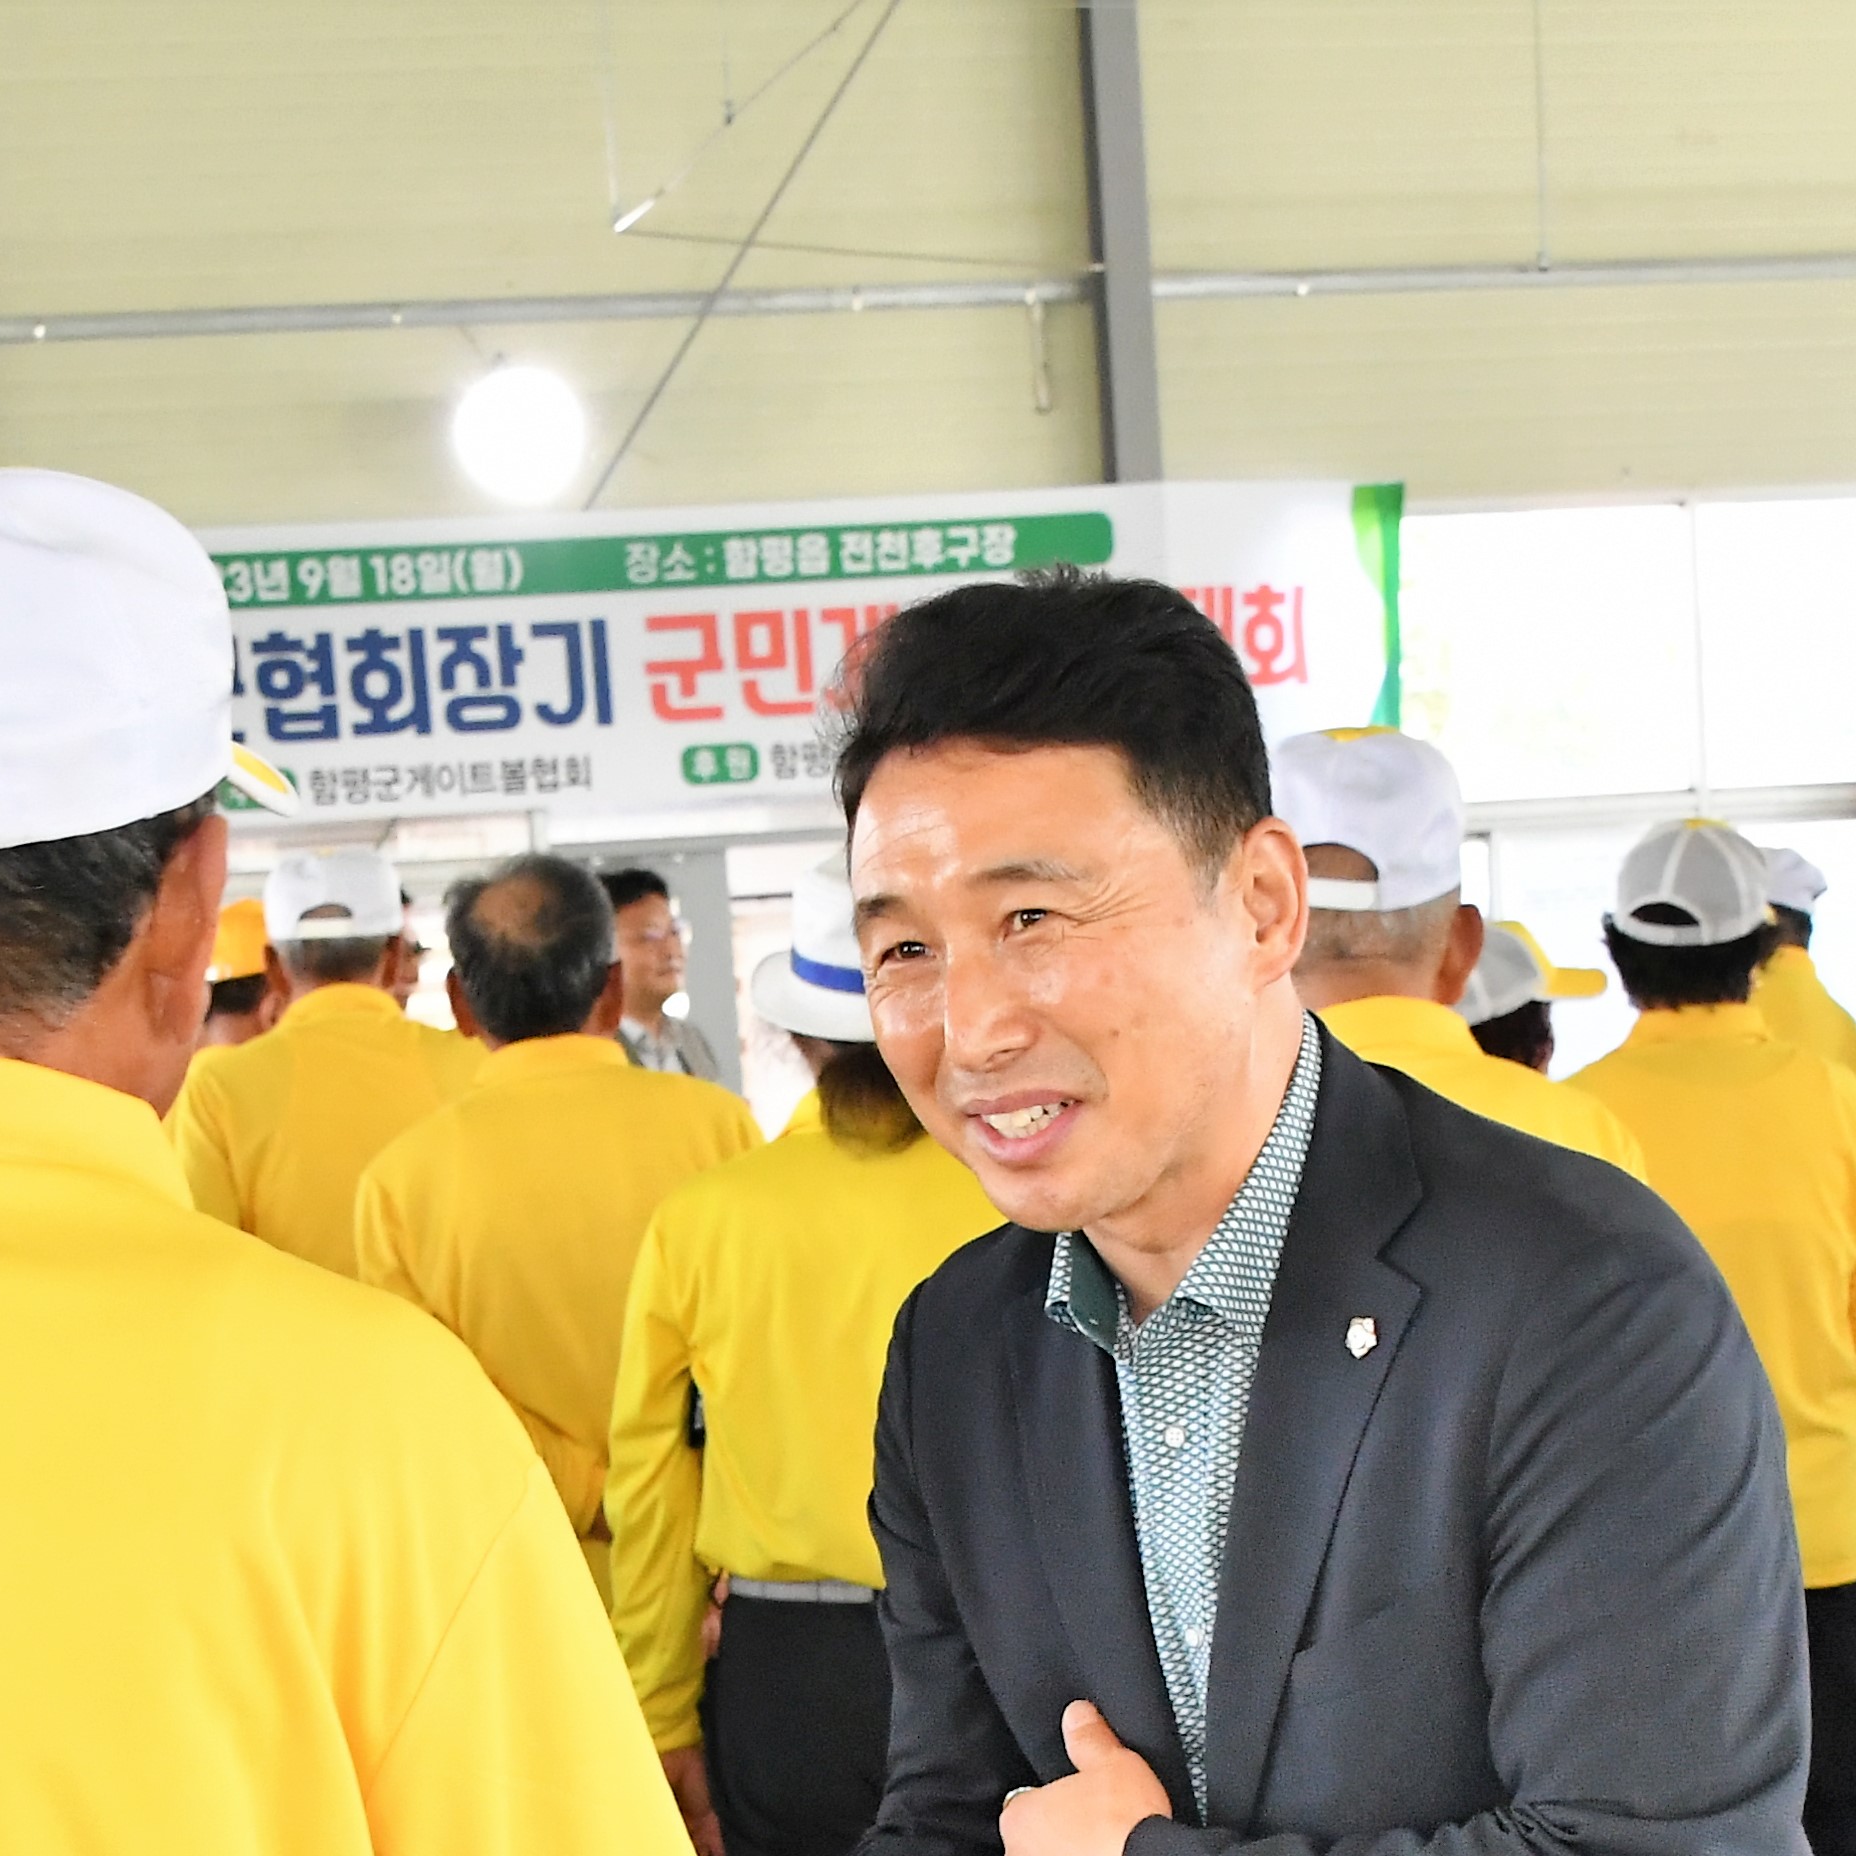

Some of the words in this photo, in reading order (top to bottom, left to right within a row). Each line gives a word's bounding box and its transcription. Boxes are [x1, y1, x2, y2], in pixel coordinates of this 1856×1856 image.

[216, 556, 291, 602] 3년
[297, 554, 362, 599] 9월
[232, 617, 614, 743] 협회장기
